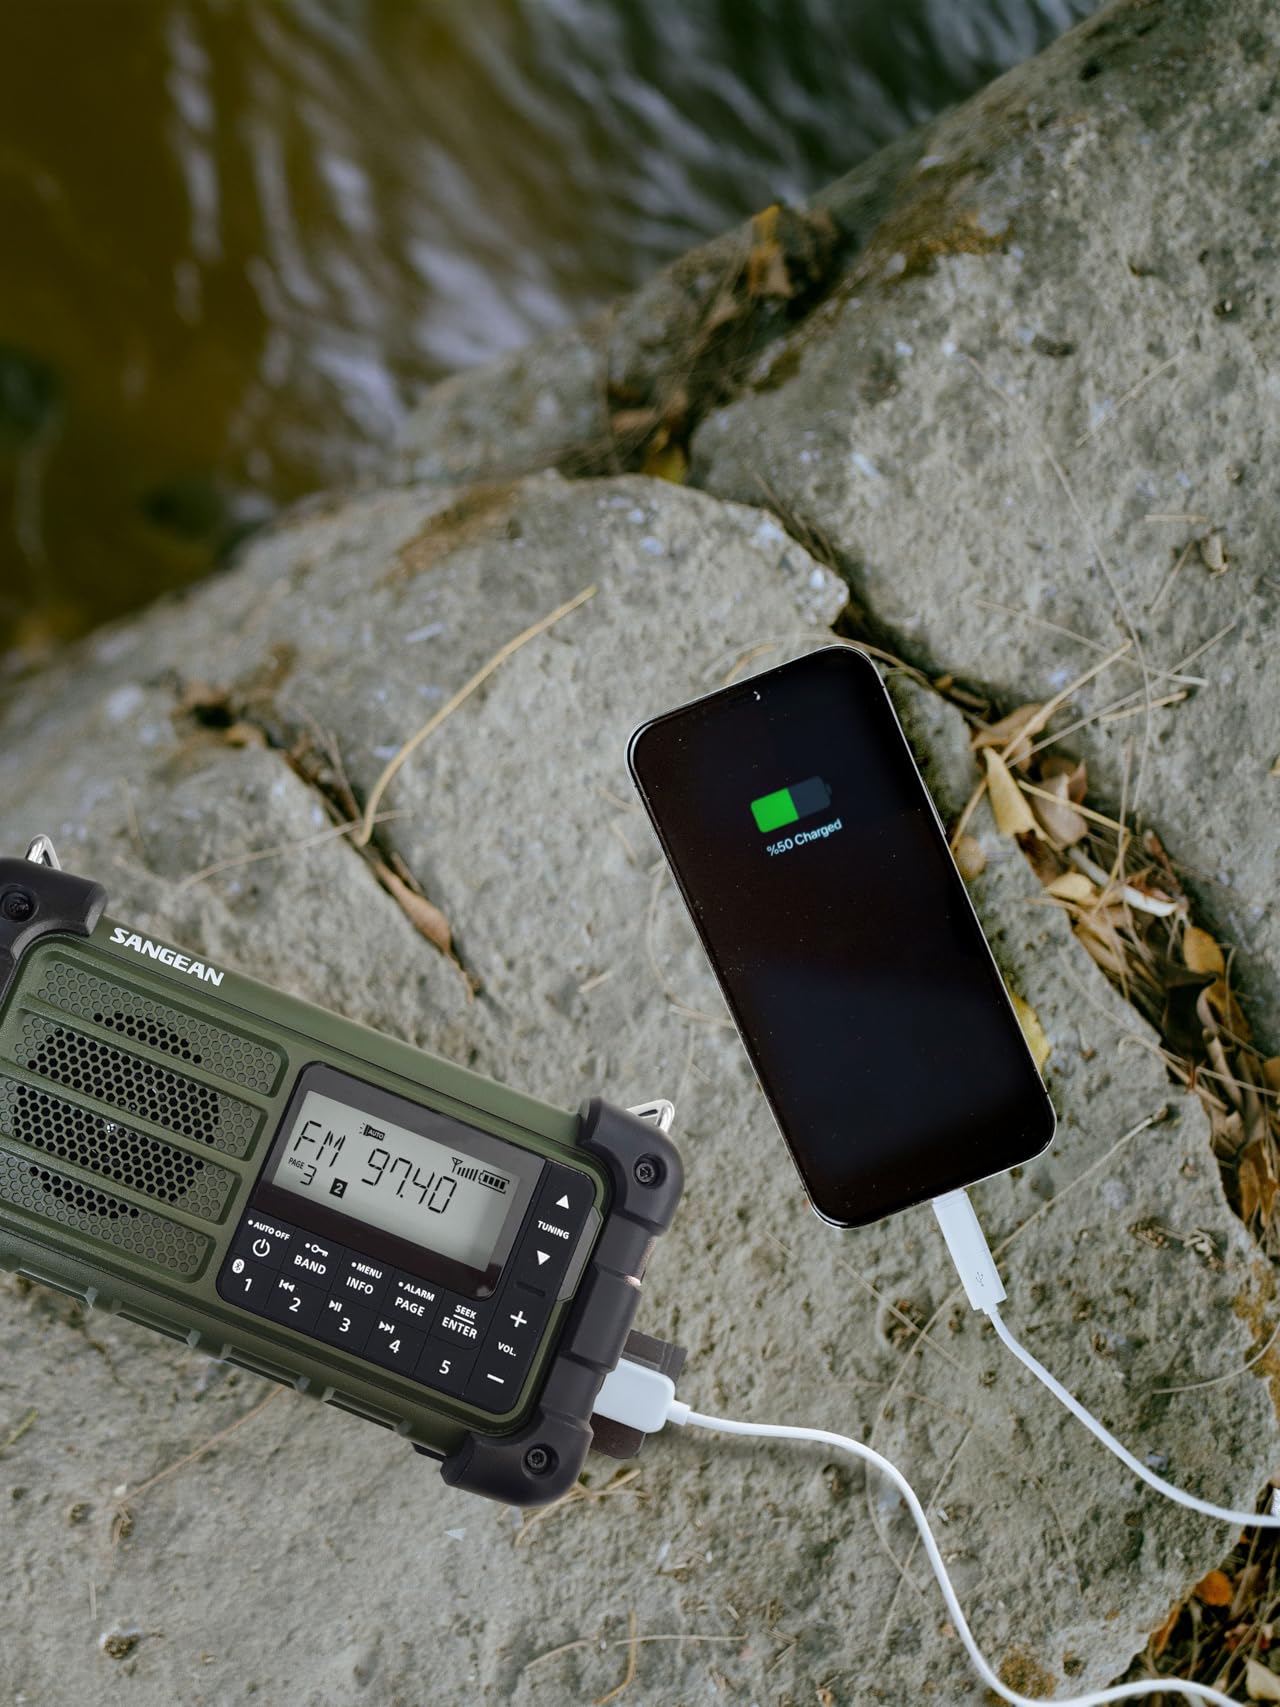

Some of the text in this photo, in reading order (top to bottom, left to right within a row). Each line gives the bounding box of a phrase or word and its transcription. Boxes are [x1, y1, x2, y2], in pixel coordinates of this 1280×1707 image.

[766, 817, 843, 856] %50 Charged
[109, 927, 225, 986] SANGEAN
[367, 1128, 385, 1140] AUTO
[288, 1157, 305, 1170] PAGE
[293, 1120, 457, 1214] FM 97.40
[300, 1165, 317, 1186] 3
[253, 1221, 290, 1241] AUTO OFF
[537, 1220, 570, 1240] TUNING
[293, 1254, 326, 1275] BAND
[356, 1262, 383, 1279] MENU
[244, 1278, 253, 1292] 1
[346, 1276, 374, 1295] INFO
[403, 1283, 435, 1302] ALARM
[289, 1297, 301, 1313] 2
[394, 1296, 425, 1317] PAGE
[454, 1304, 477, 1320] SEEK
[339, 1317, 351, 1333] 3
[441, 1316, 478, 1340] ENTER
[388, 1339, 401, 1354] 4
[497, 1341, 517, 1357] VOL.
[438, 1360, 451, 1375] 5
